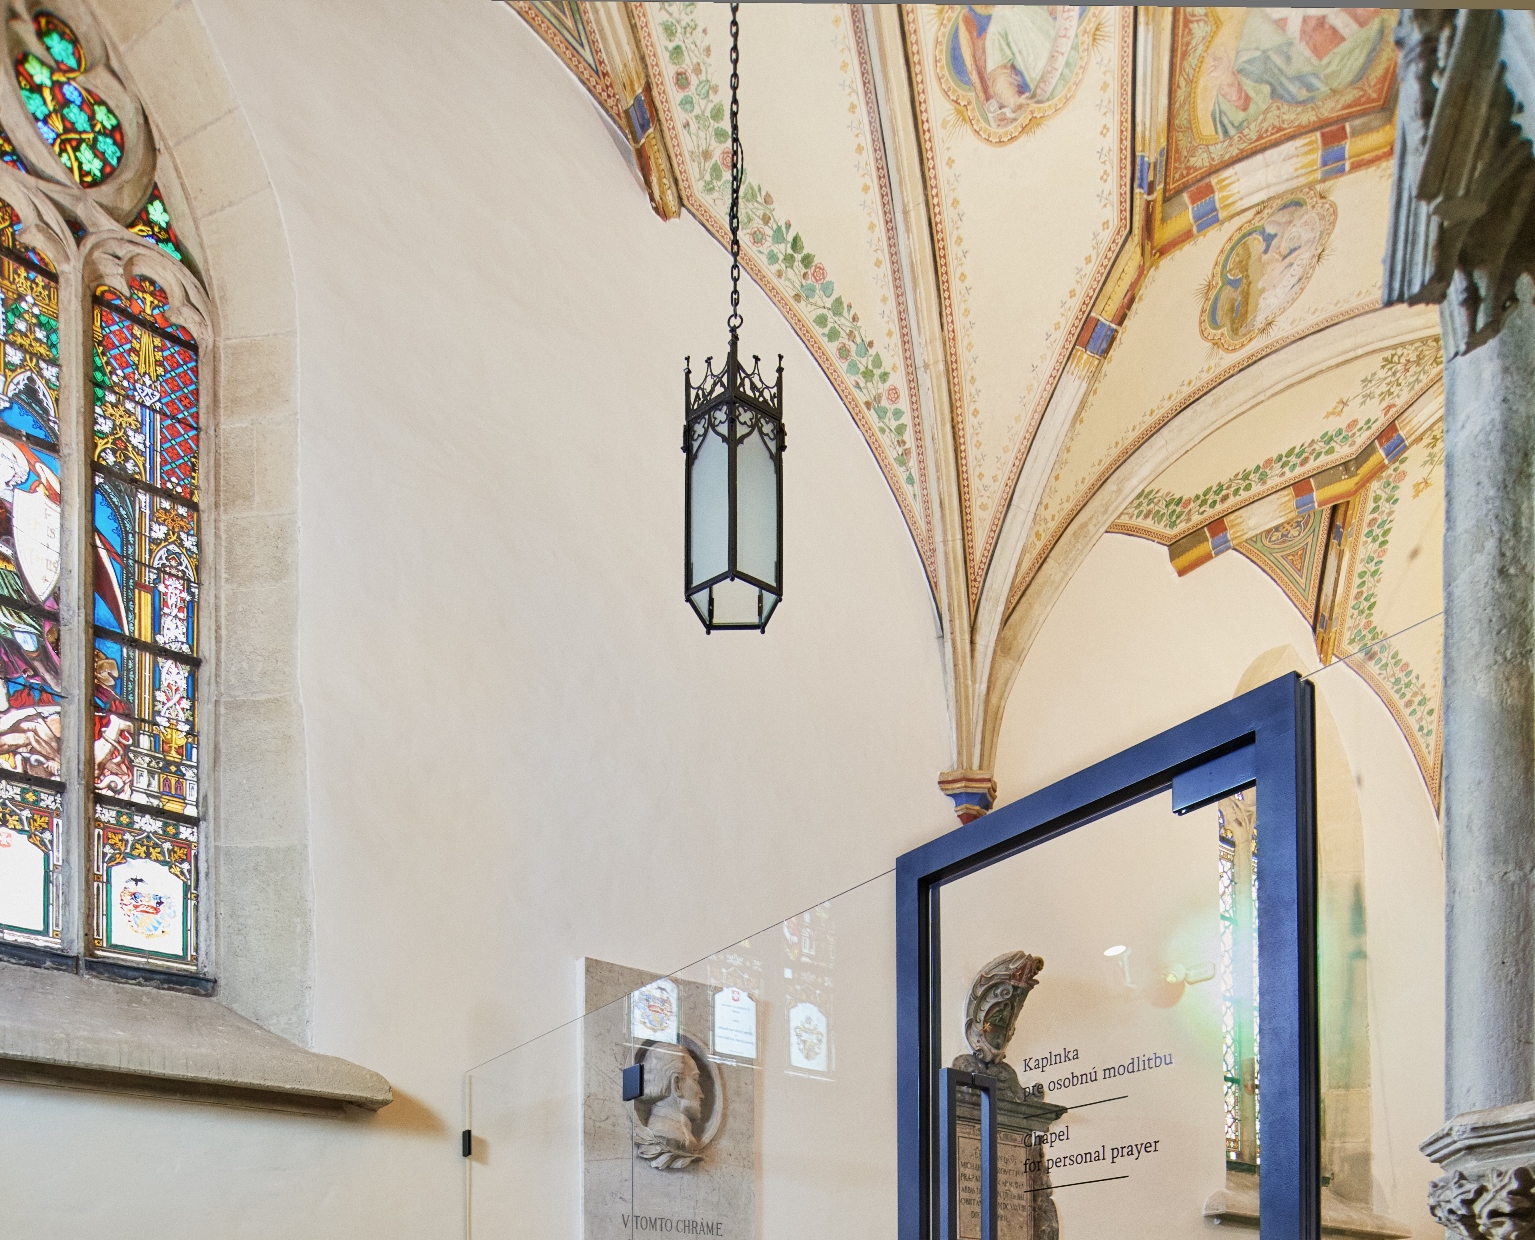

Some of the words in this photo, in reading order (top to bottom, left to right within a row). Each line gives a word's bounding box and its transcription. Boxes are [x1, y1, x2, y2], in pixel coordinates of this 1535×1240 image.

[1022, 1047, 1080, 1073] Kaplnka
[1022, 1083, 1044, 1102] pre
[1047, 1066, 1099, 1092] osobnú
[1102, 1052, 1174, 1080] modlitbu
[1023, 1125, 1071, 1148] Chapel
[1023, 1158, 1043, 1173] for
[1046, 1145, 1106, 1174] personal
[1110, 1139, 1160, 1164] prayer
[621, 1213, 630, 1228] V
[633, 1215, 673, 1233] TOMTO
[675, 1217, 723, 1237] CHRÁME
